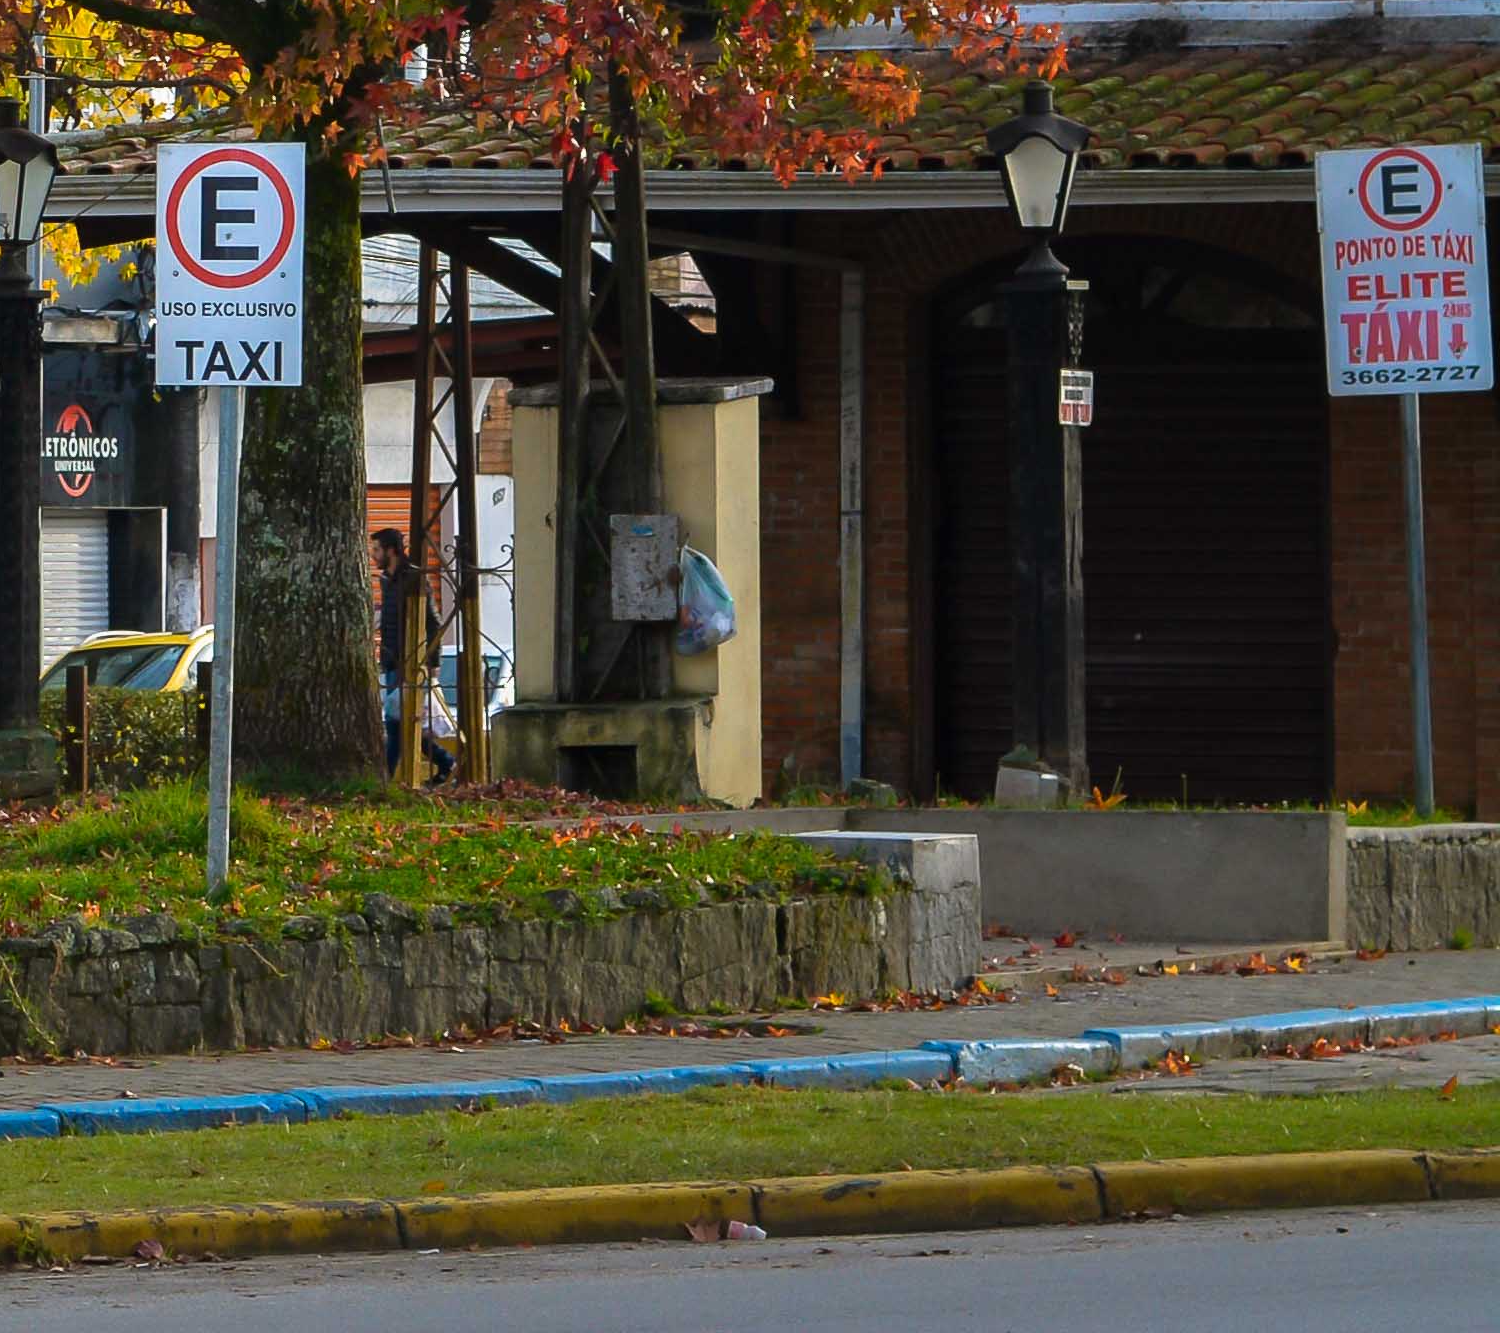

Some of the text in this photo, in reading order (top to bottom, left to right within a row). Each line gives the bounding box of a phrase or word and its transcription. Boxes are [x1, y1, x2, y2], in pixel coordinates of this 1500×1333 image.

[1381, 164, 1422, 215] E
[200, 176, 259, 261] E
[1335, 229, 1474, 270] PONTO DE TÁXI
[1347, 270, 1467, 302] ELITE
[161, 301, 296, 318] USO EXCLUSIVO
[1340, 302, 1441, 364] TÁXI
[175, 340, 282, 381] TAXI
[1342, 365, 1480, 386] 3662-2727
[54, 460, 95, 472] UNIVERSAL
